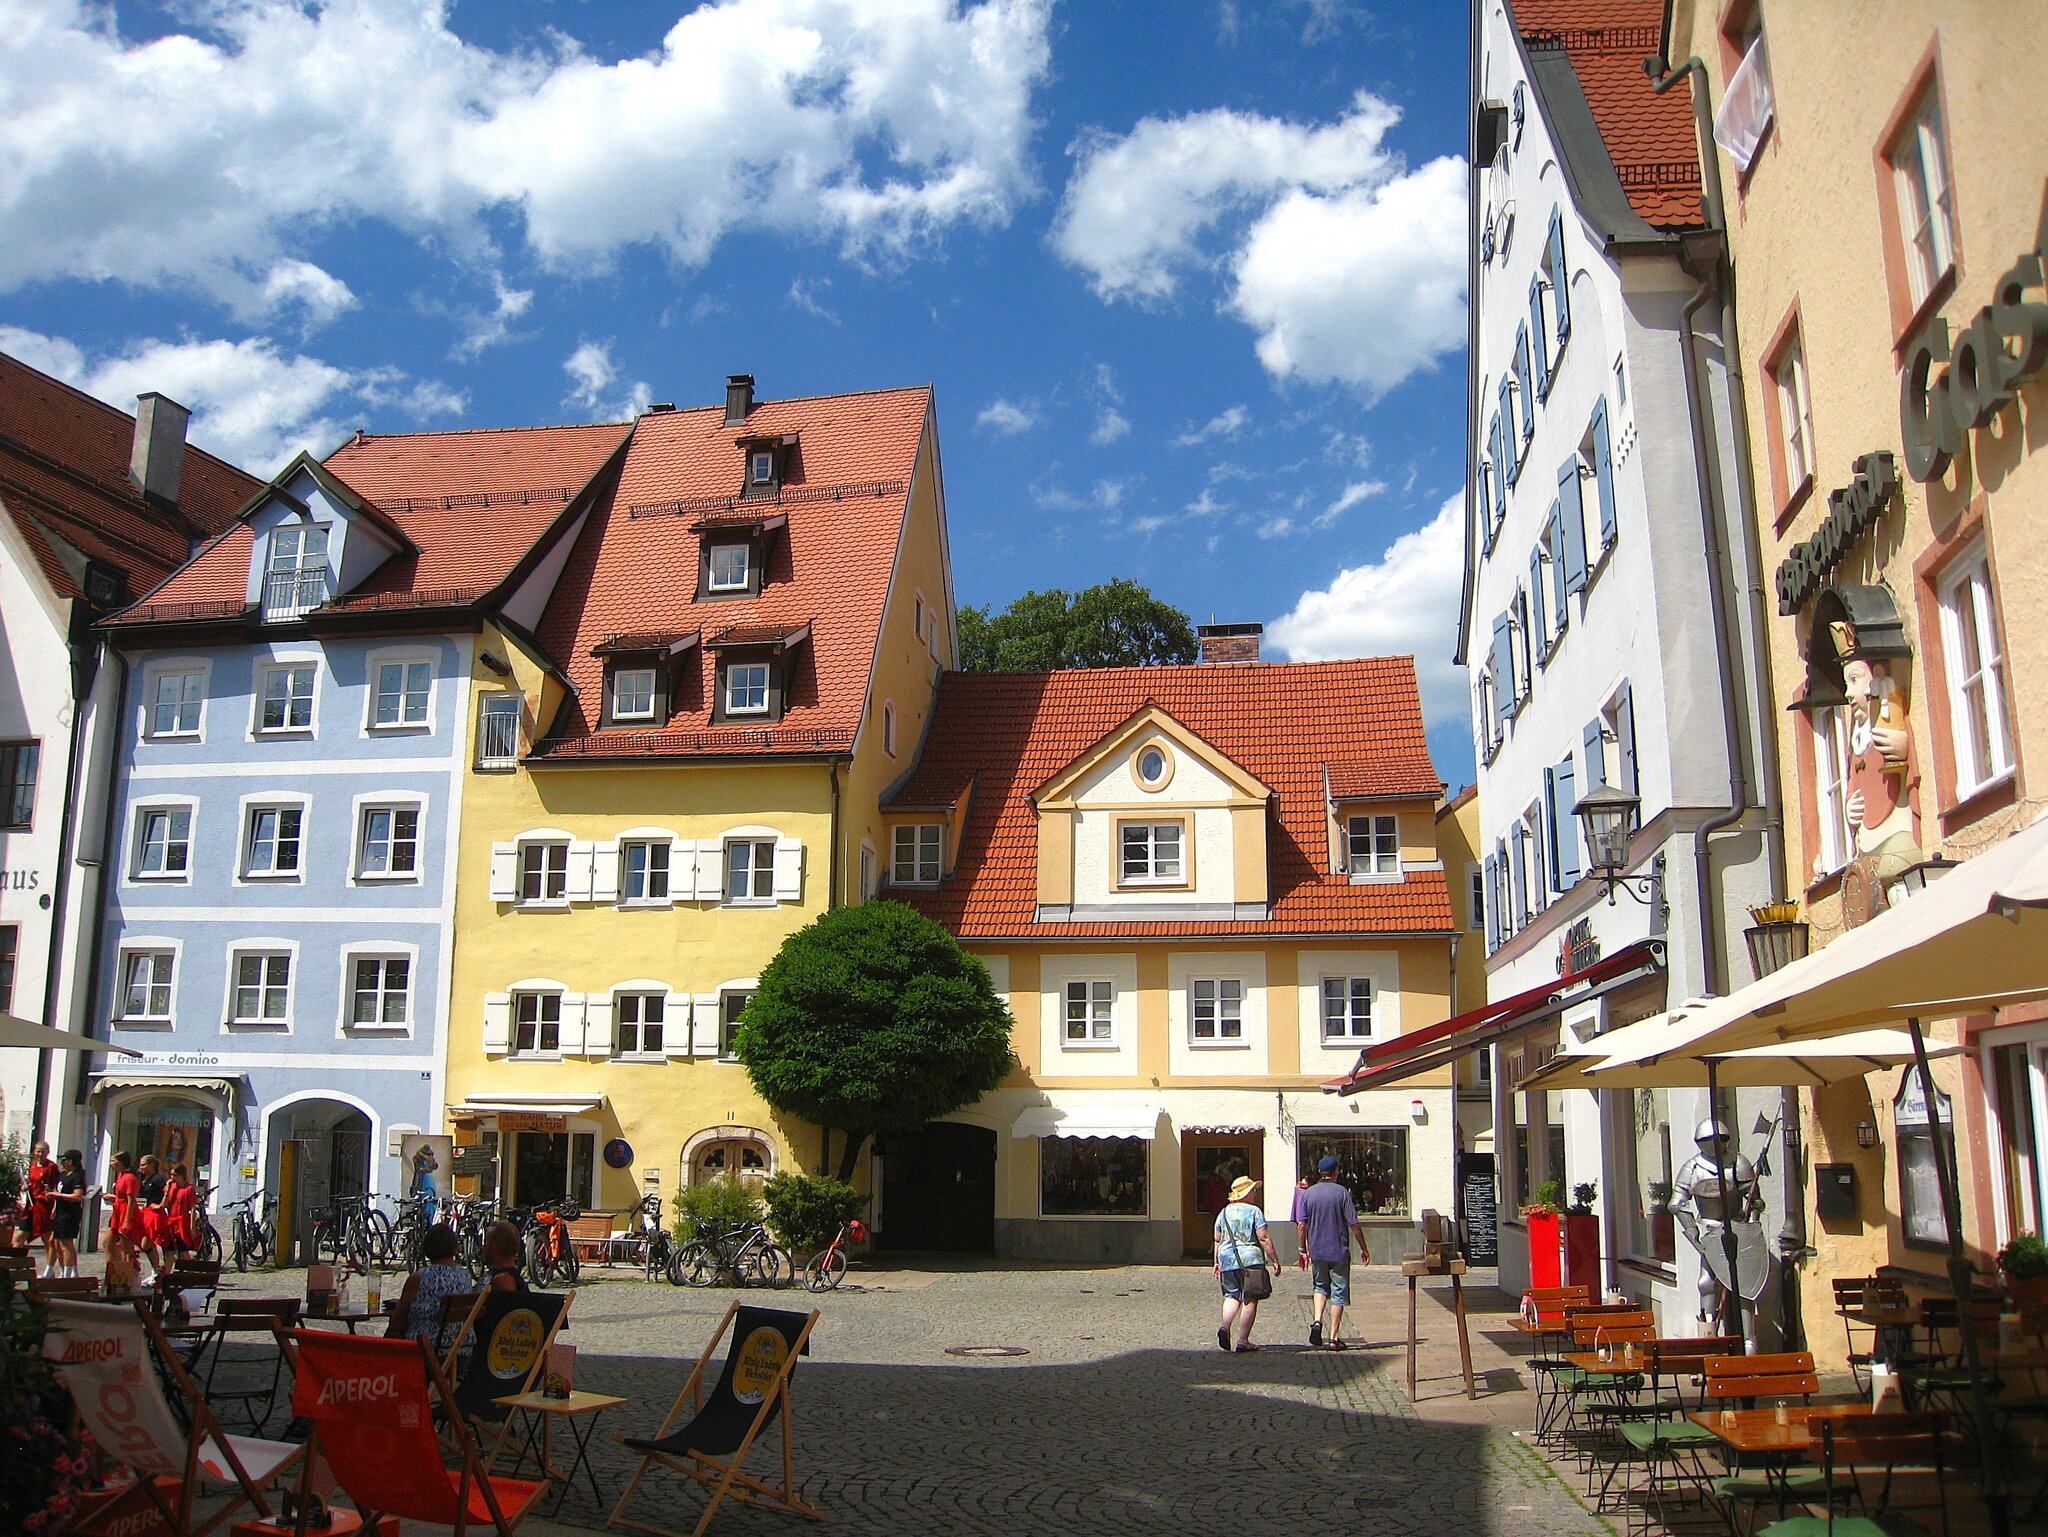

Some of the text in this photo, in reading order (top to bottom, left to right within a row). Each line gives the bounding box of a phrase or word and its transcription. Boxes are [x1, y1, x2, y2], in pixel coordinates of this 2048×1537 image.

[20, 1085, 27, 1097] 7
[61, 1338, 124, 1362] APEROL
[317, 1374, 399, 1406] APEROL
